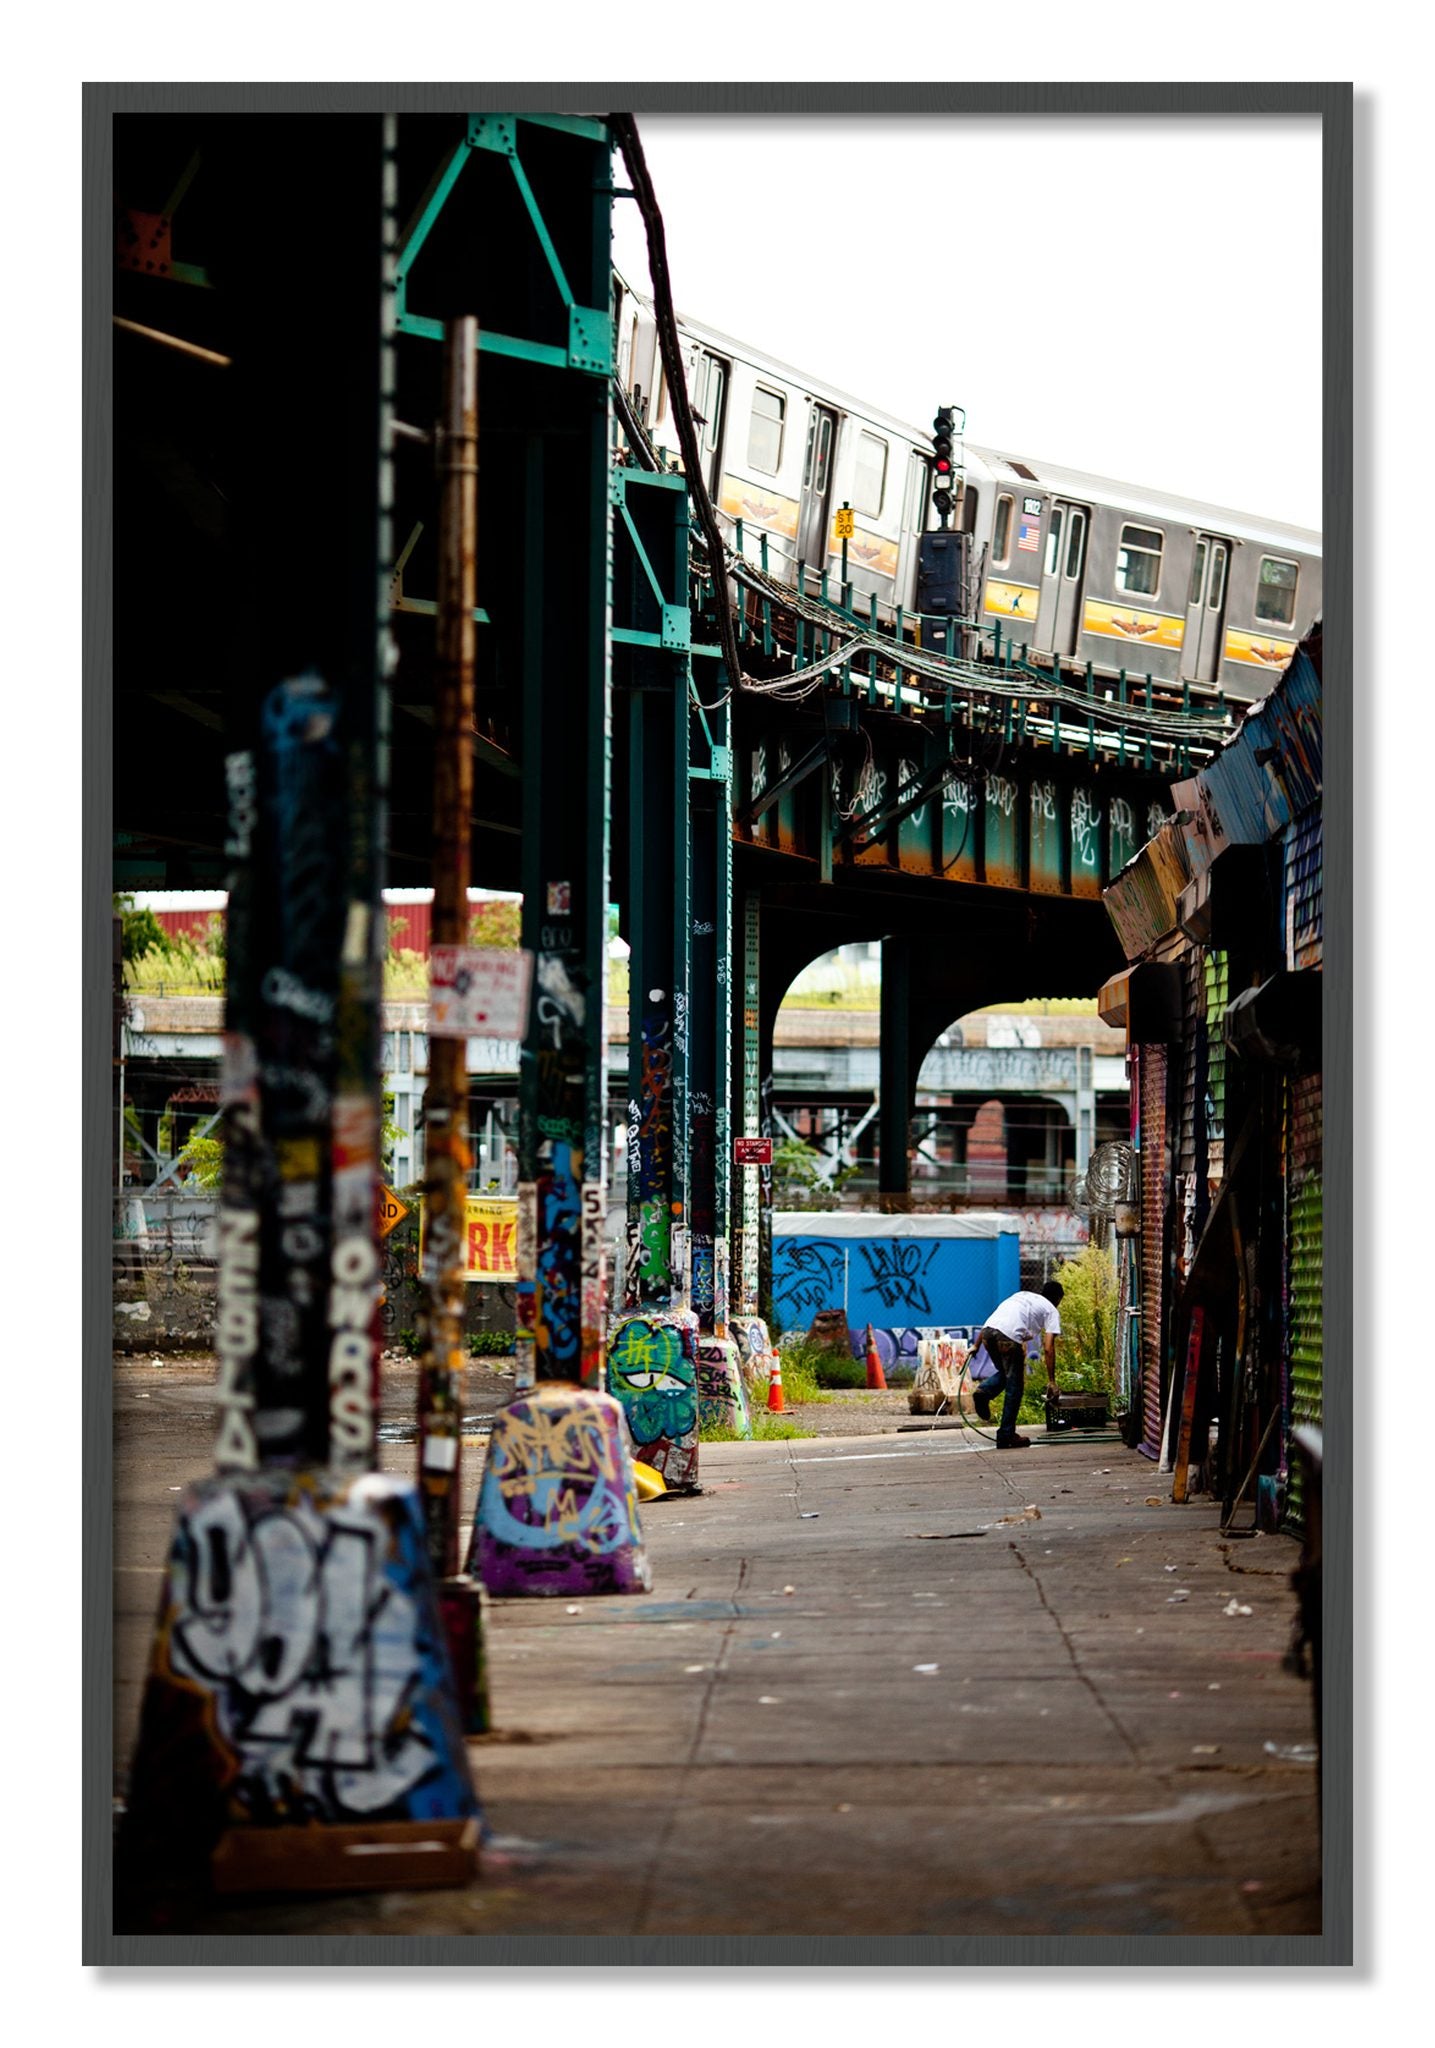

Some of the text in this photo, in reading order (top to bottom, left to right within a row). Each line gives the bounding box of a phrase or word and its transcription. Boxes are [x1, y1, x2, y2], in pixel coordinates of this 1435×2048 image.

[838, 524, 852, 535] 20
[466, 1205, 502, 1216] ARKING
[467, 1222, 514, 1271] RK
